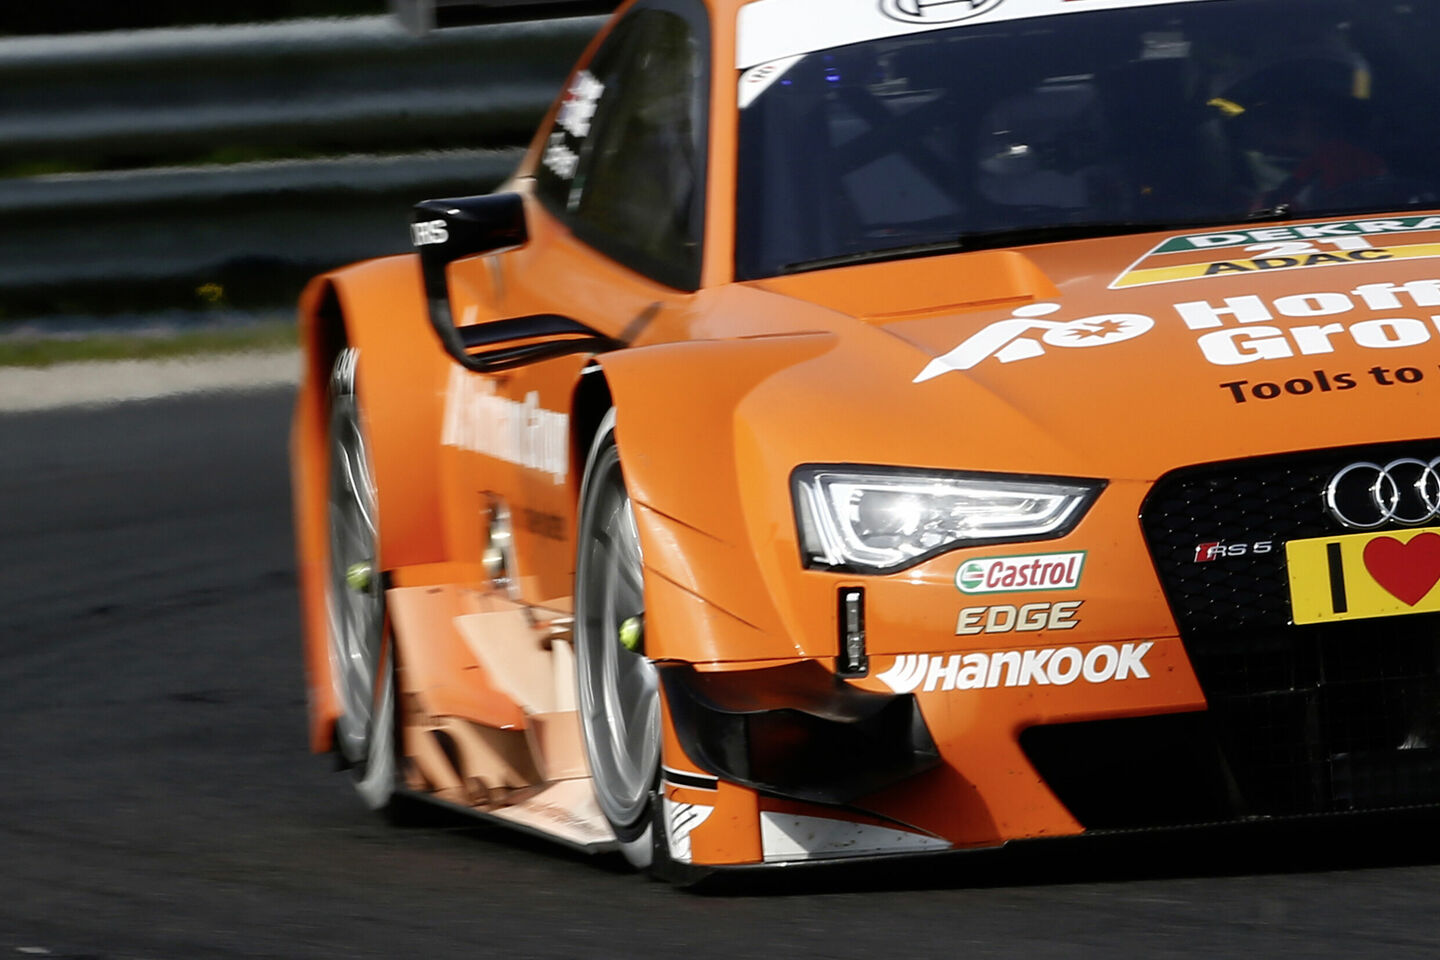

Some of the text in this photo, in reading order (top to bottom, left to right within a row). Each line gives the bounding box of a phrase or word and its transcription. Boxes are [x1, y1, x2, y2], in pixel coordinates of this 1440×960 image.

[1203, 249, 1395, 276] ADAC
[1243, 235, 1376, 259] 21
[1220, 370, 1357, 404] Tools
[1368, 366, 1424, 386] to
[984, 555, 1076, 589] Castrol
[1326, 542, 1348, 614] I
[956, 600, 1085, 635] EDGE
